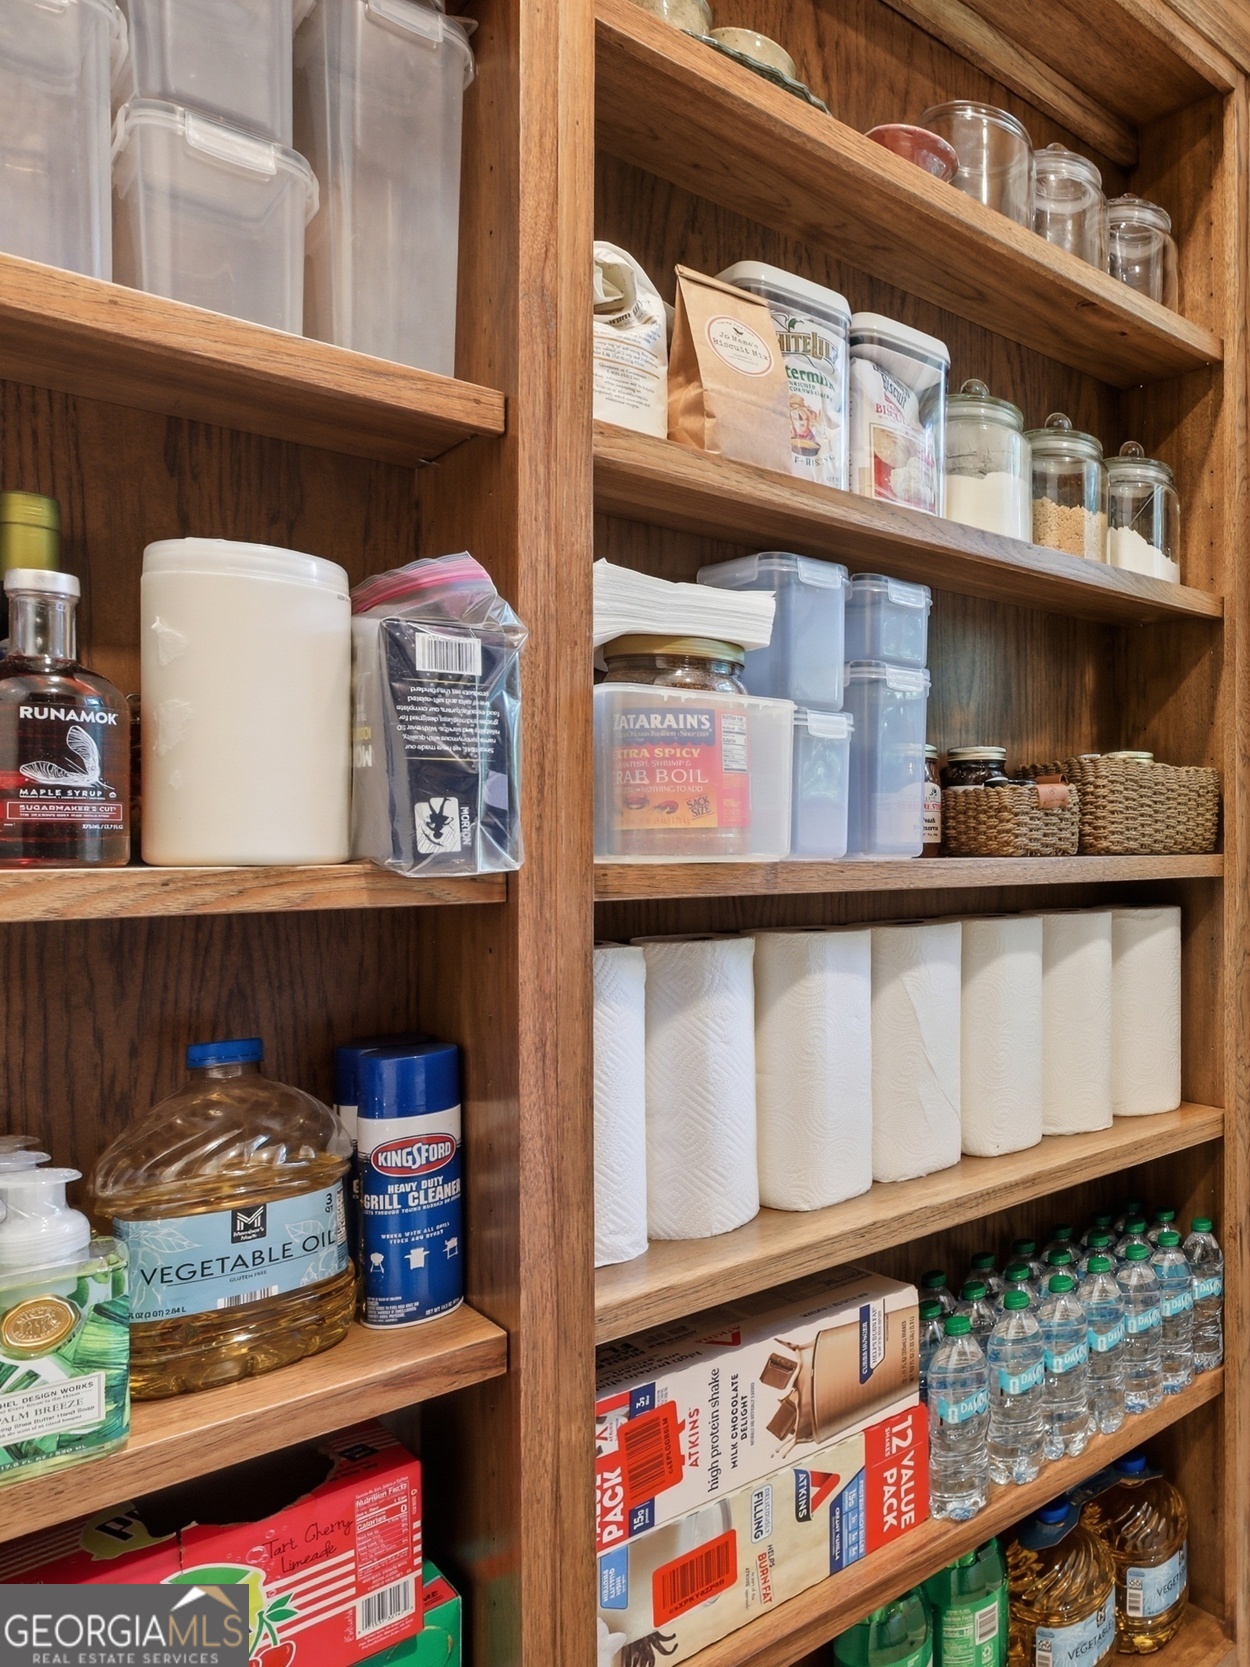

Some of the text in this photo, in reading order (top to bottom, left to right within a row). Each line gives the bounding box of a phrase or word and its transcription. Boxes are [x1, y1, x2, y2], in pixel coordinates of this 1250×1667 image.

[776, 333, 811, 353] HITE
[20, 706, 117, 725] RUNAMOK
[654, 748, 700, 758] SPICY
[615, 769, 708, 784] RAB BOIL
[20, 788, 102, 797] MAPLE SYRUP
[687, 795, 710, 810] SACK
[20, 804, 96, 812] SUGARMAKER'S
[691, 806, 711, 818] SIZE
[461, 806, 470, 846] MORTON
[378, 1143, 452, 1169] KINGSFORD
[326, 1193, 333, 1205] 3
[364, 1178, 461, 1210] GRILL CLEANER
[388, 1176, 444, 1195] HEAVY DUTY
[140, 1230, 338, 1286] VEGETABLE OIL
[165, 1307, 181, 1316] 2.84
[22, 1381, 94, 1404] DESIGN WORKS
[731, 1373, 739, 1440] CHOCOLATE
[35, 1397, 84, 1417] BREEZE
[689, 1407, 700, 1468] ATKINS
[708, 1367, 722, 1493] high protein shake
[892, 1415, 913, 1455] 12
[798, 1473, 807, 1519] ATKINS
[883, 1467, 898, 1533] PACK
[901, 1450, 915, 1529] VALUE
[603, 1466, 624, 1544] PACK
[754, 1491, 763, 1540] FILLING
[634, 1509, 645, 1530] 15g
[263, 1518, 354, 1560] Tart Cherry
[282, 1543, 337, 1574] Limeade
[758, 1552, 772, 1605] BURN FAT
